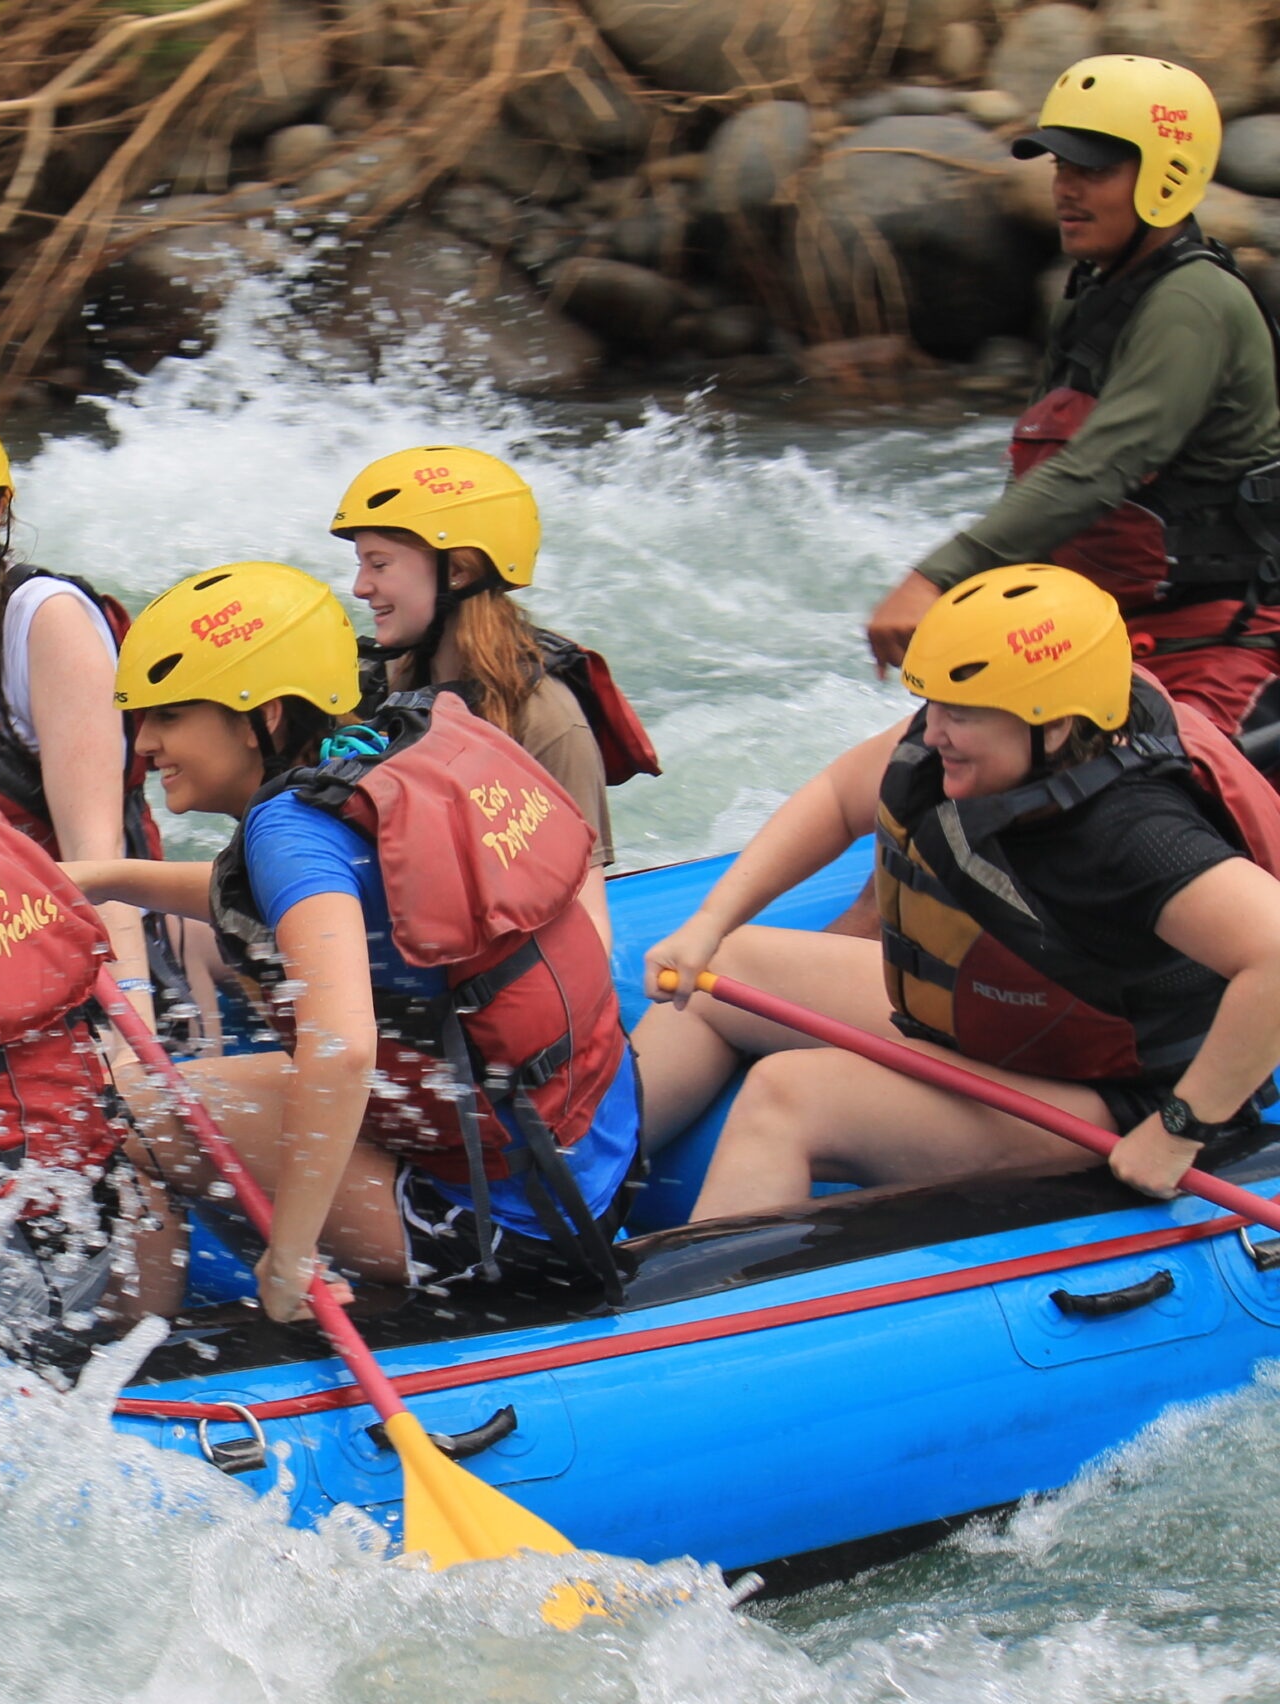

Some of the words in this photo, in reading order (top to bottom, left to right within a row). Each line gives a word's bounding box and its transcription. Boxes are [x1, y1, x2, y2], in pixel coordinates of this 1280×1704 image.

[209, 617, 264, 648] trips
[1024, 639, 1072, 664] trips
[972, 980, 1048, 1007] REVERE
